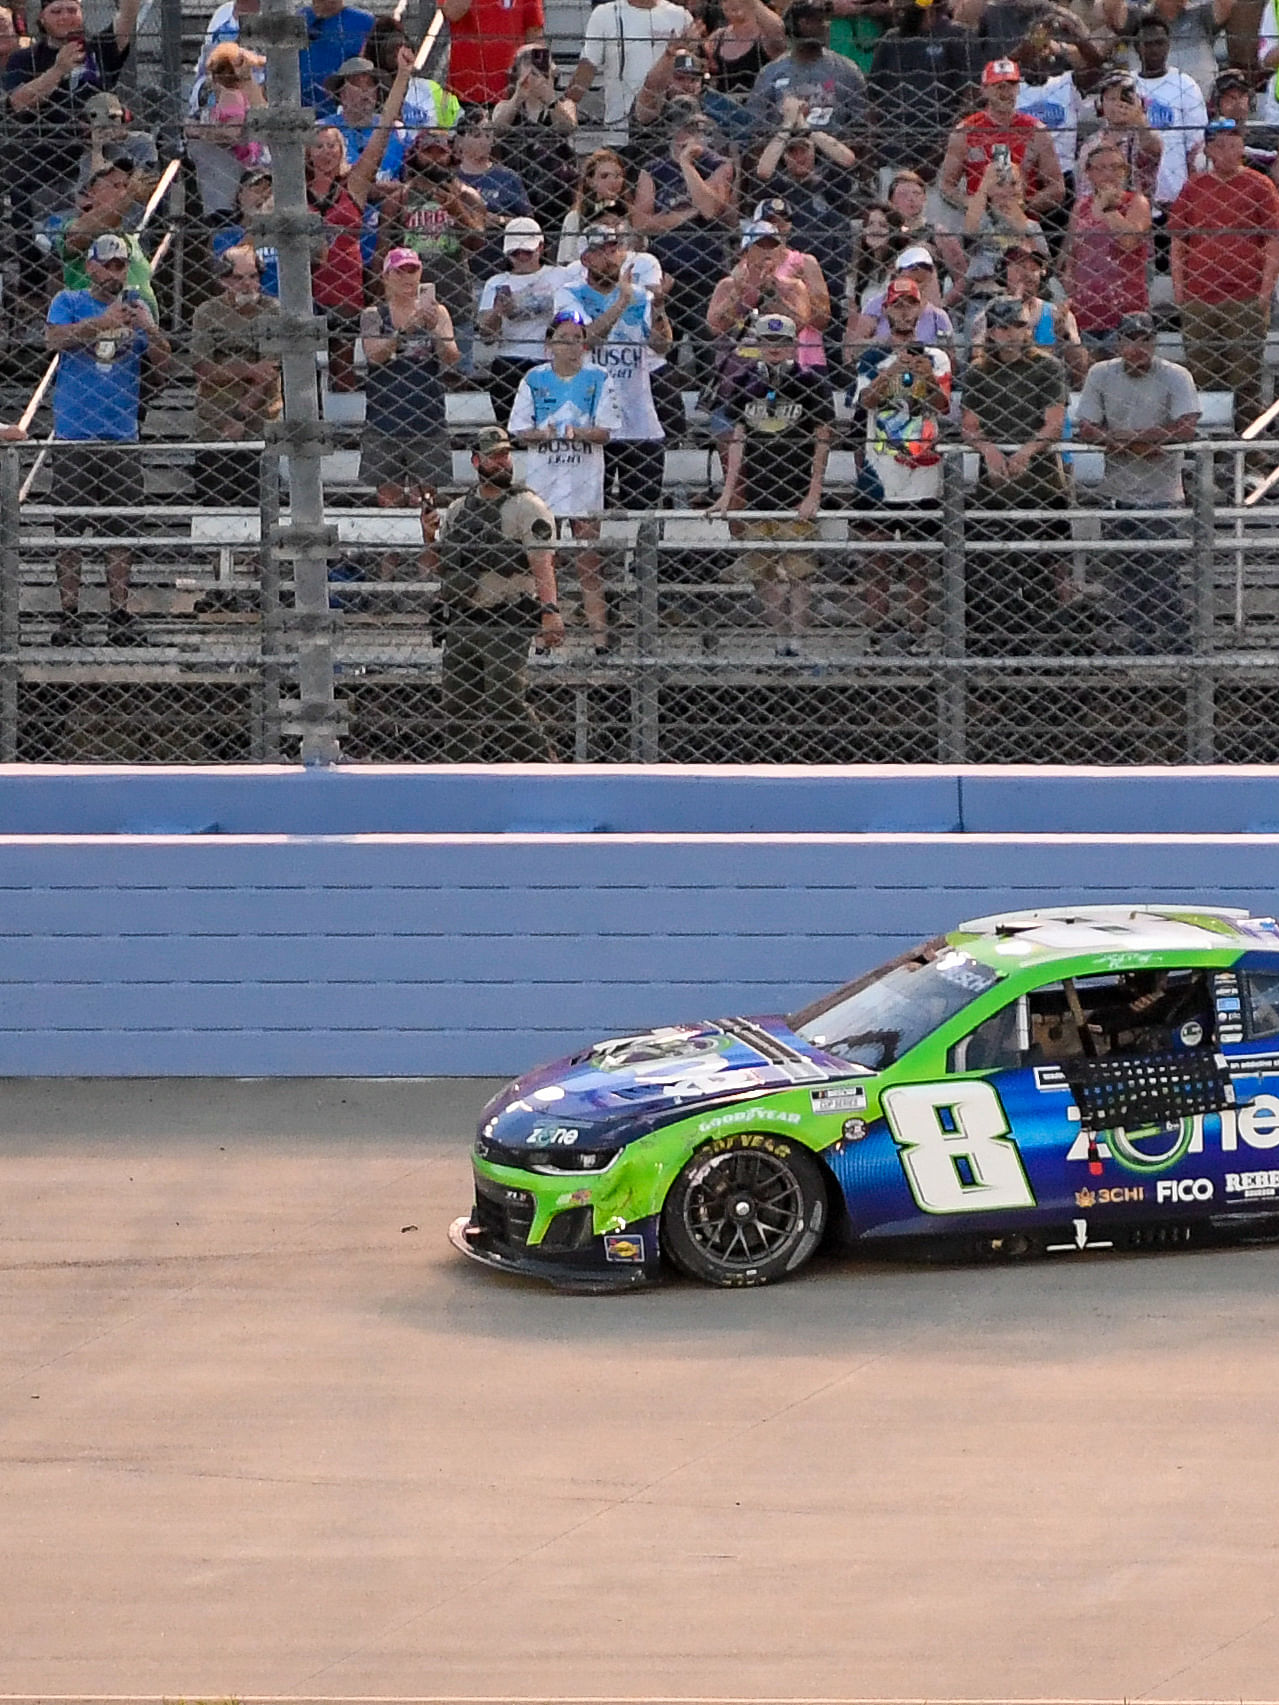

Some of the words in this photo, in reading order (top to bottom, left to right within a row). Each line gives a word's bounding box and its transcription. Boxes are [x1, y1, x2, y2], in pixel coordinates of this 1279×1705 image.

[698, 1106, 800, 1132] GOODYEAR
[878, 1079, 1037, 1214] 8
[1098, 1187, 1145, 1204] 3CHI
[1157, 1178, 1214, 1204] FICO
